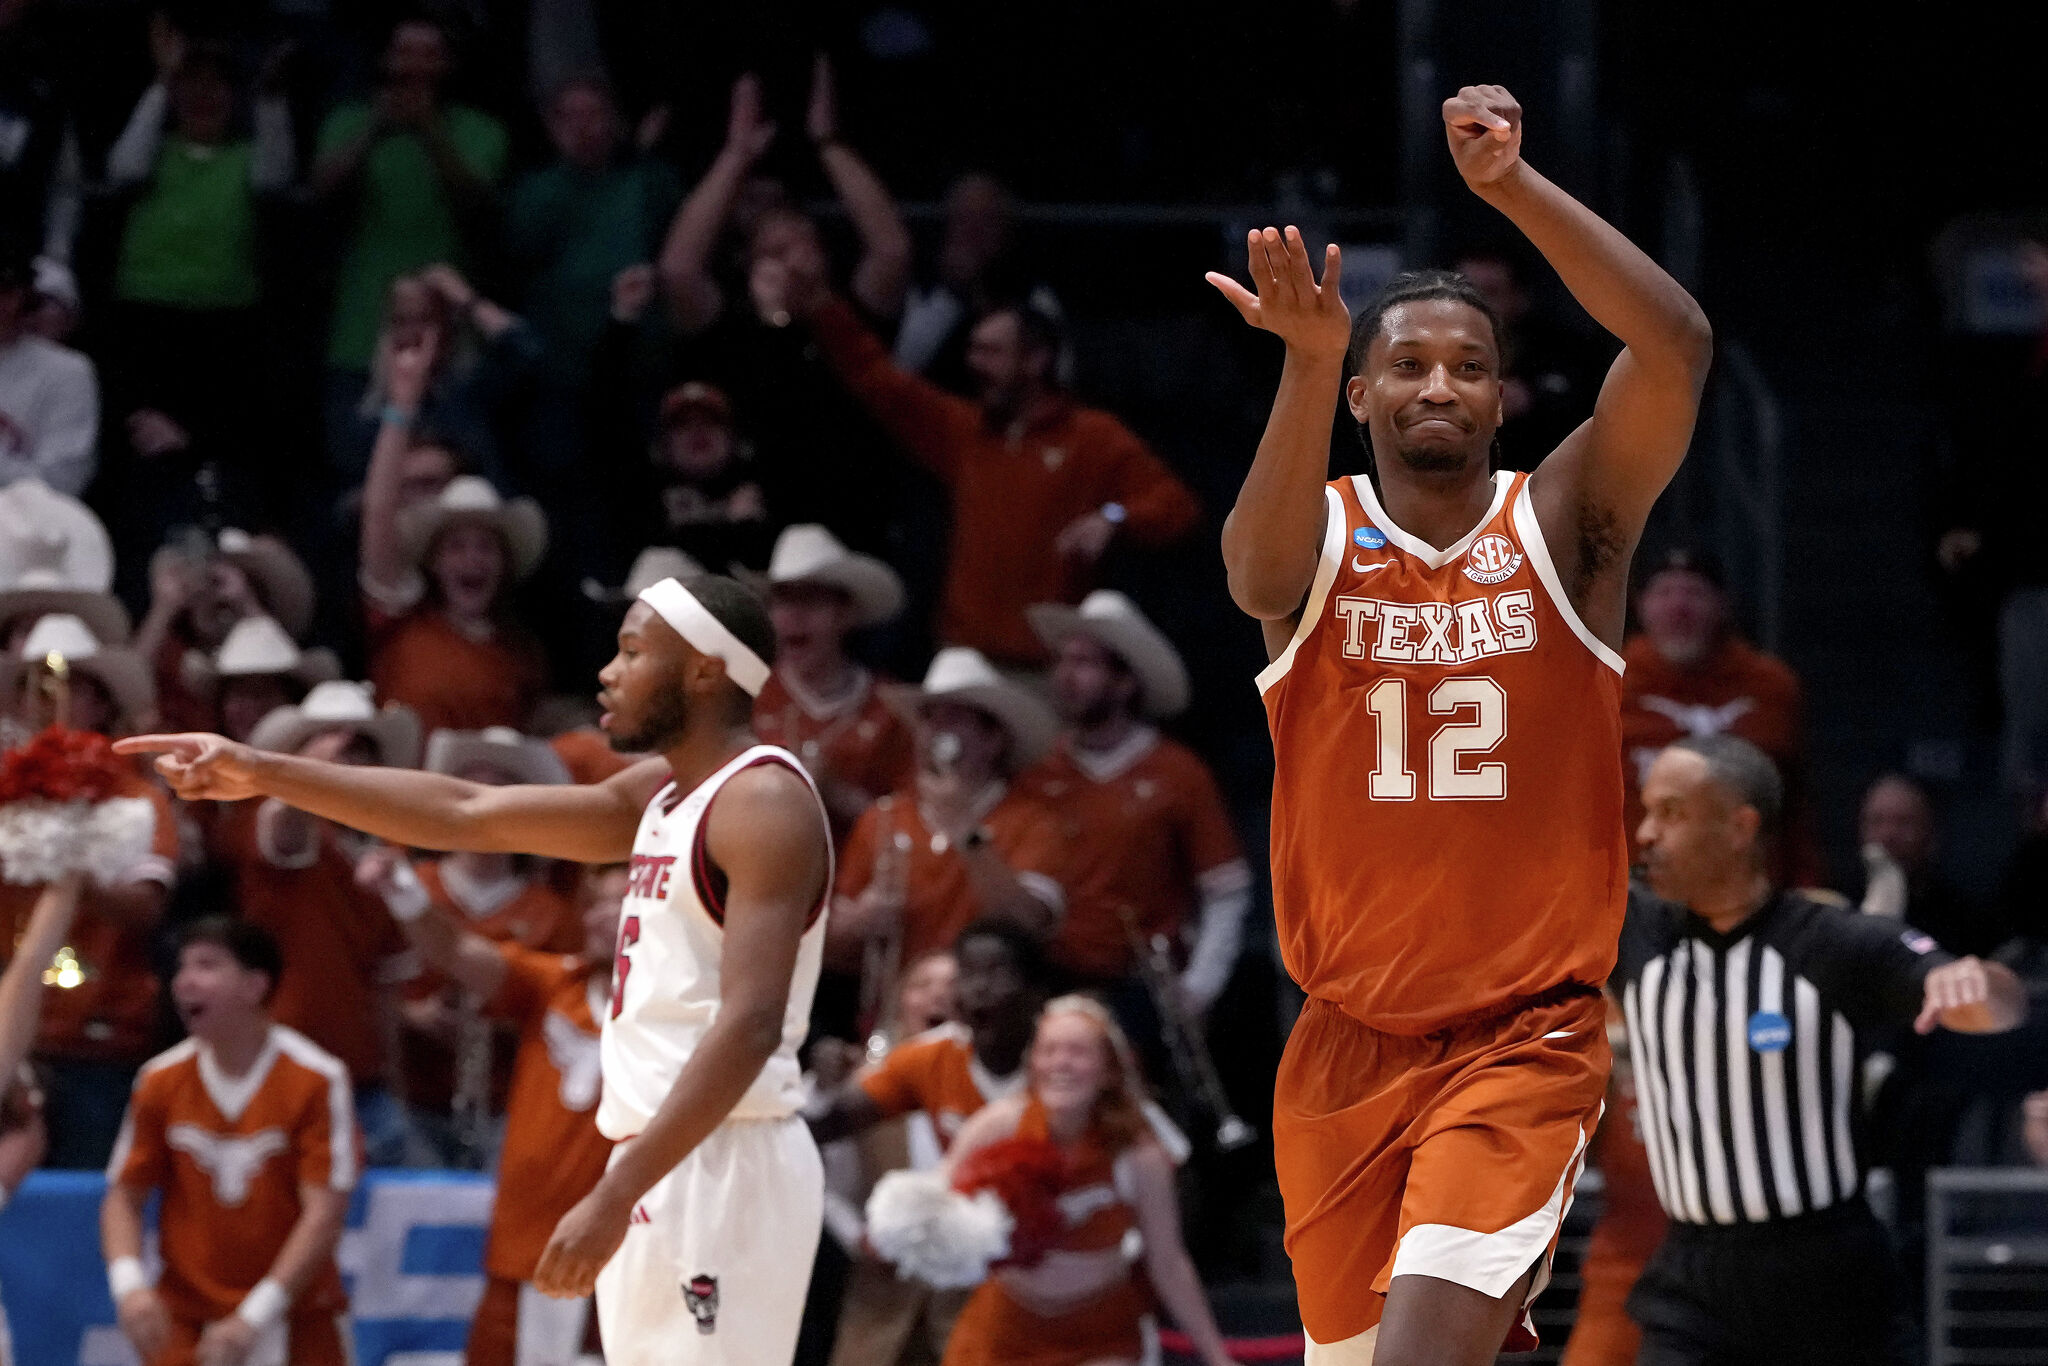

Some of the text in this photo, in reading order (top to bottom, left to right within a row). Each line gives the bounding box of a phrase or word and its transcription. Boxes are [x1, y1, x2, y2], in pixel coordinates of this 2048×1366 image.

[1356, 535, 1383, 544] NCAA
[1471, 537, 1511, 572] SEC
[1470, 562, 1518, 584] GRADUATE
[1336, 589, 1538, 666] TEXAS
[1366, 676, 1507, 801] 12
